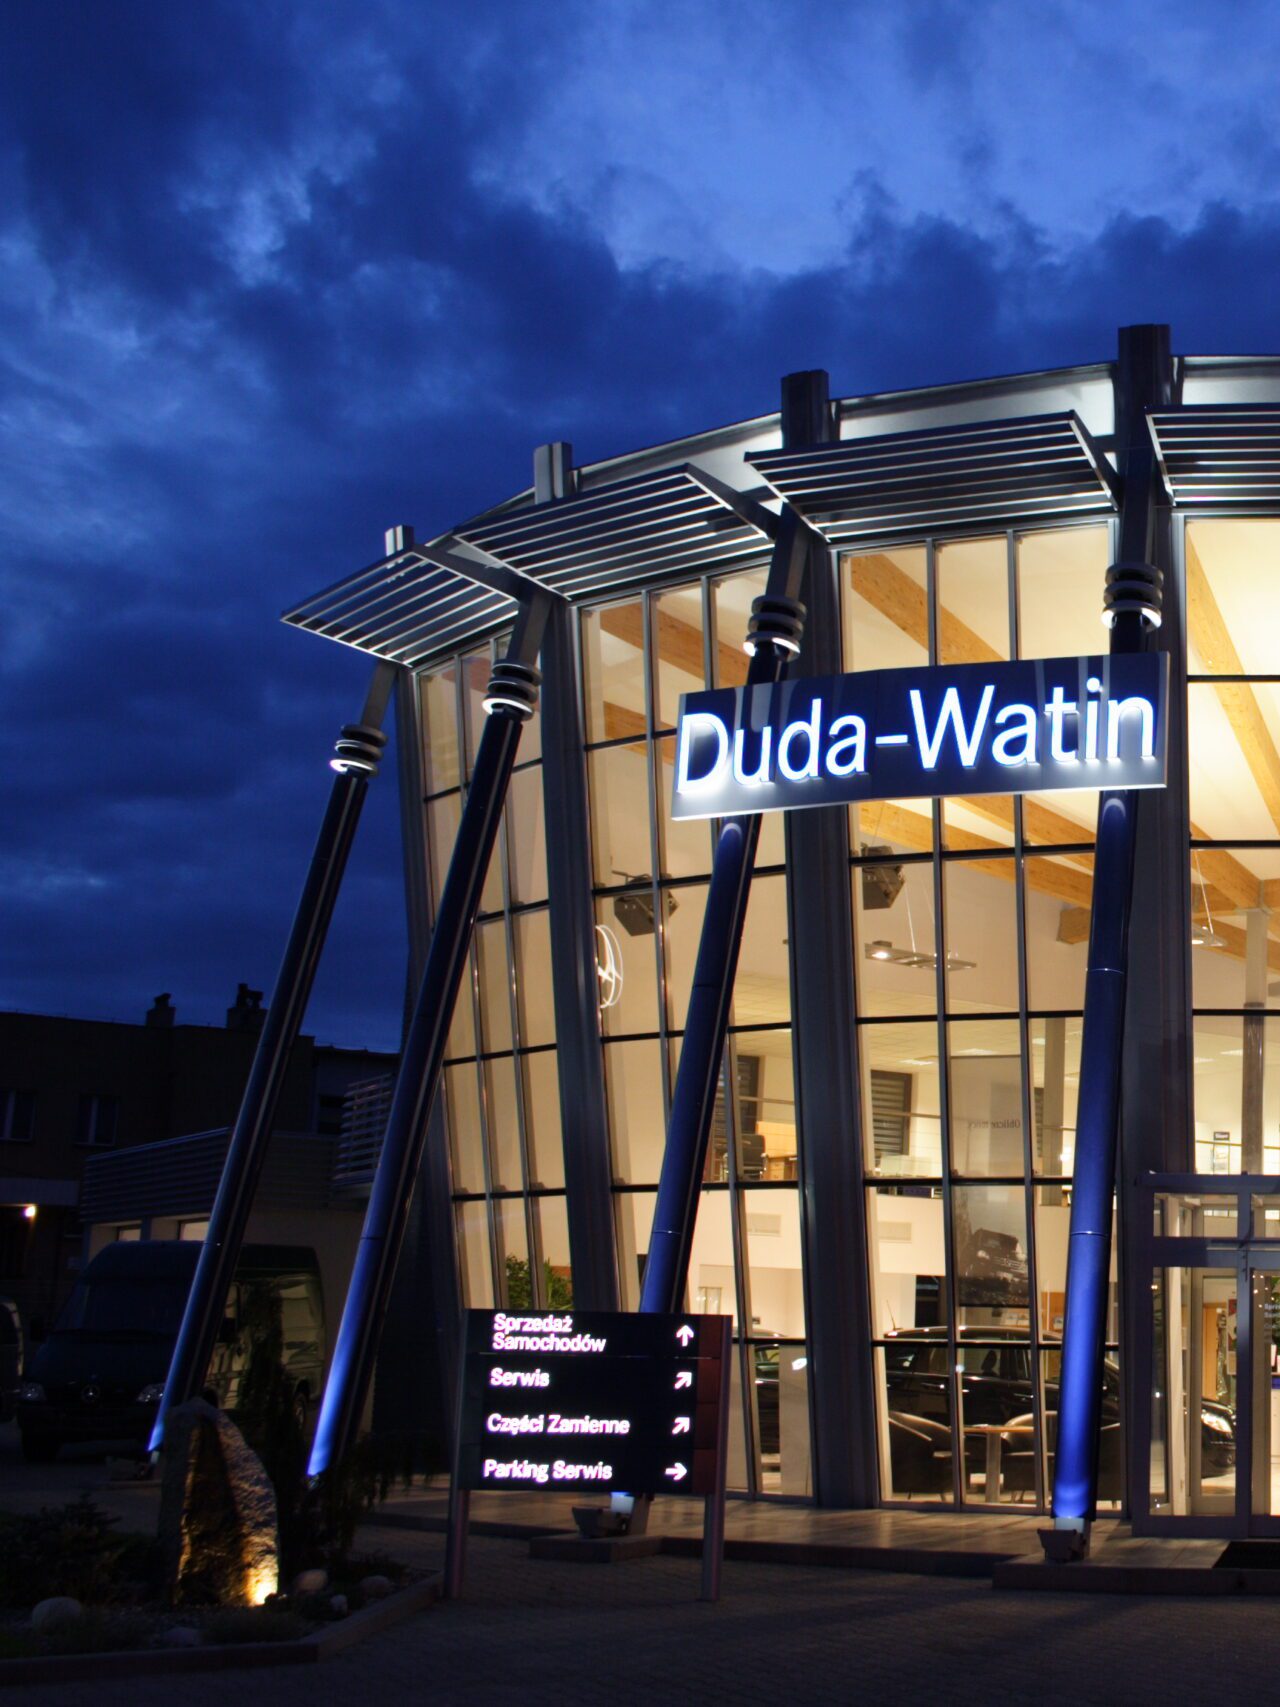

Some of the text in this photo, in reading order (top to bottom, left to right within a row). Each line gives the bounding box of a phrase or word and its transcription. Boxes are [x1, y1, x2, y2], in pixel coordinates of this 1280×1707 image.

[676, 677, 1155, 794] Duda-Watin
[493, 1313, 573, 1334] Sprzedaż
[492, 1333, 607, 1352] Samochodów
[490, 1367, 550, 1388] Serwis
[487, 1413, 630, 1435] Części Zamienne
[483, 1459, 613, 1483] Parking Serwis
